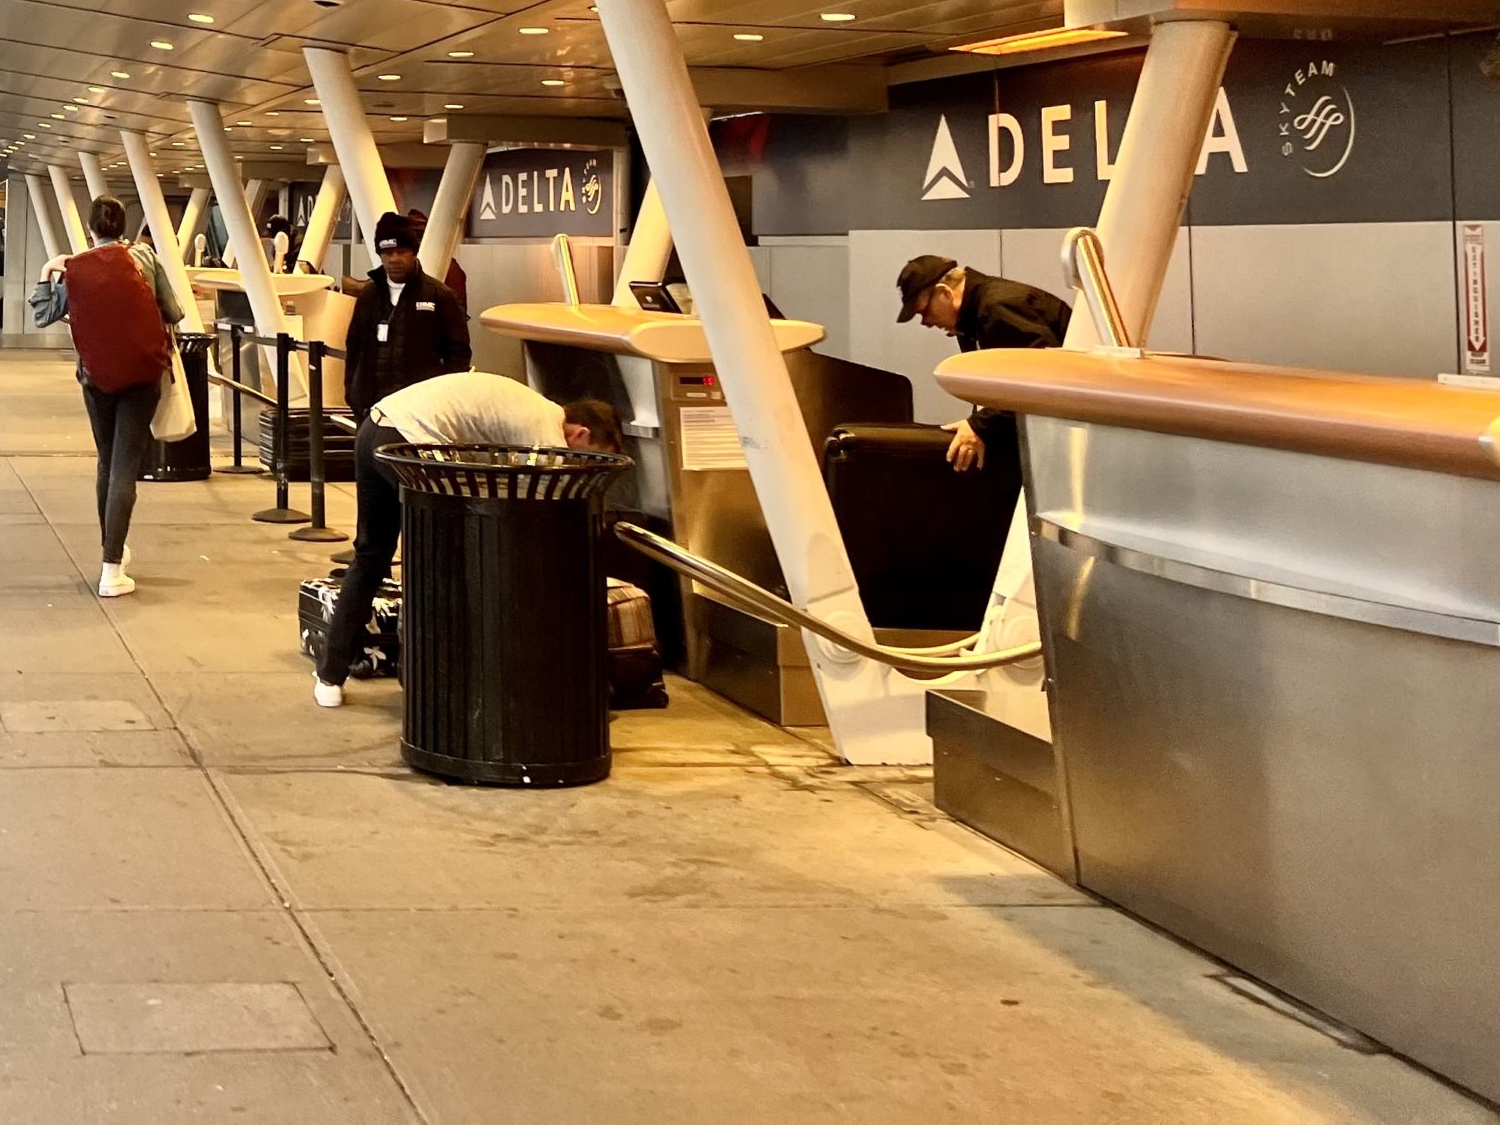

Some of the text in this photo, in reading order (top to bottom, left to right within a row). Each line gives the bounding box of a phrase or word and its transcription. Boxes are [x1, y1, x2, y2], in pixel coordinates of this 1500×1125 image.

[987, 86, 1248, 187] DELA
[1279, 60, 1334, 156] SKYTEAM
[501, 167, 576, 213] DELTA
